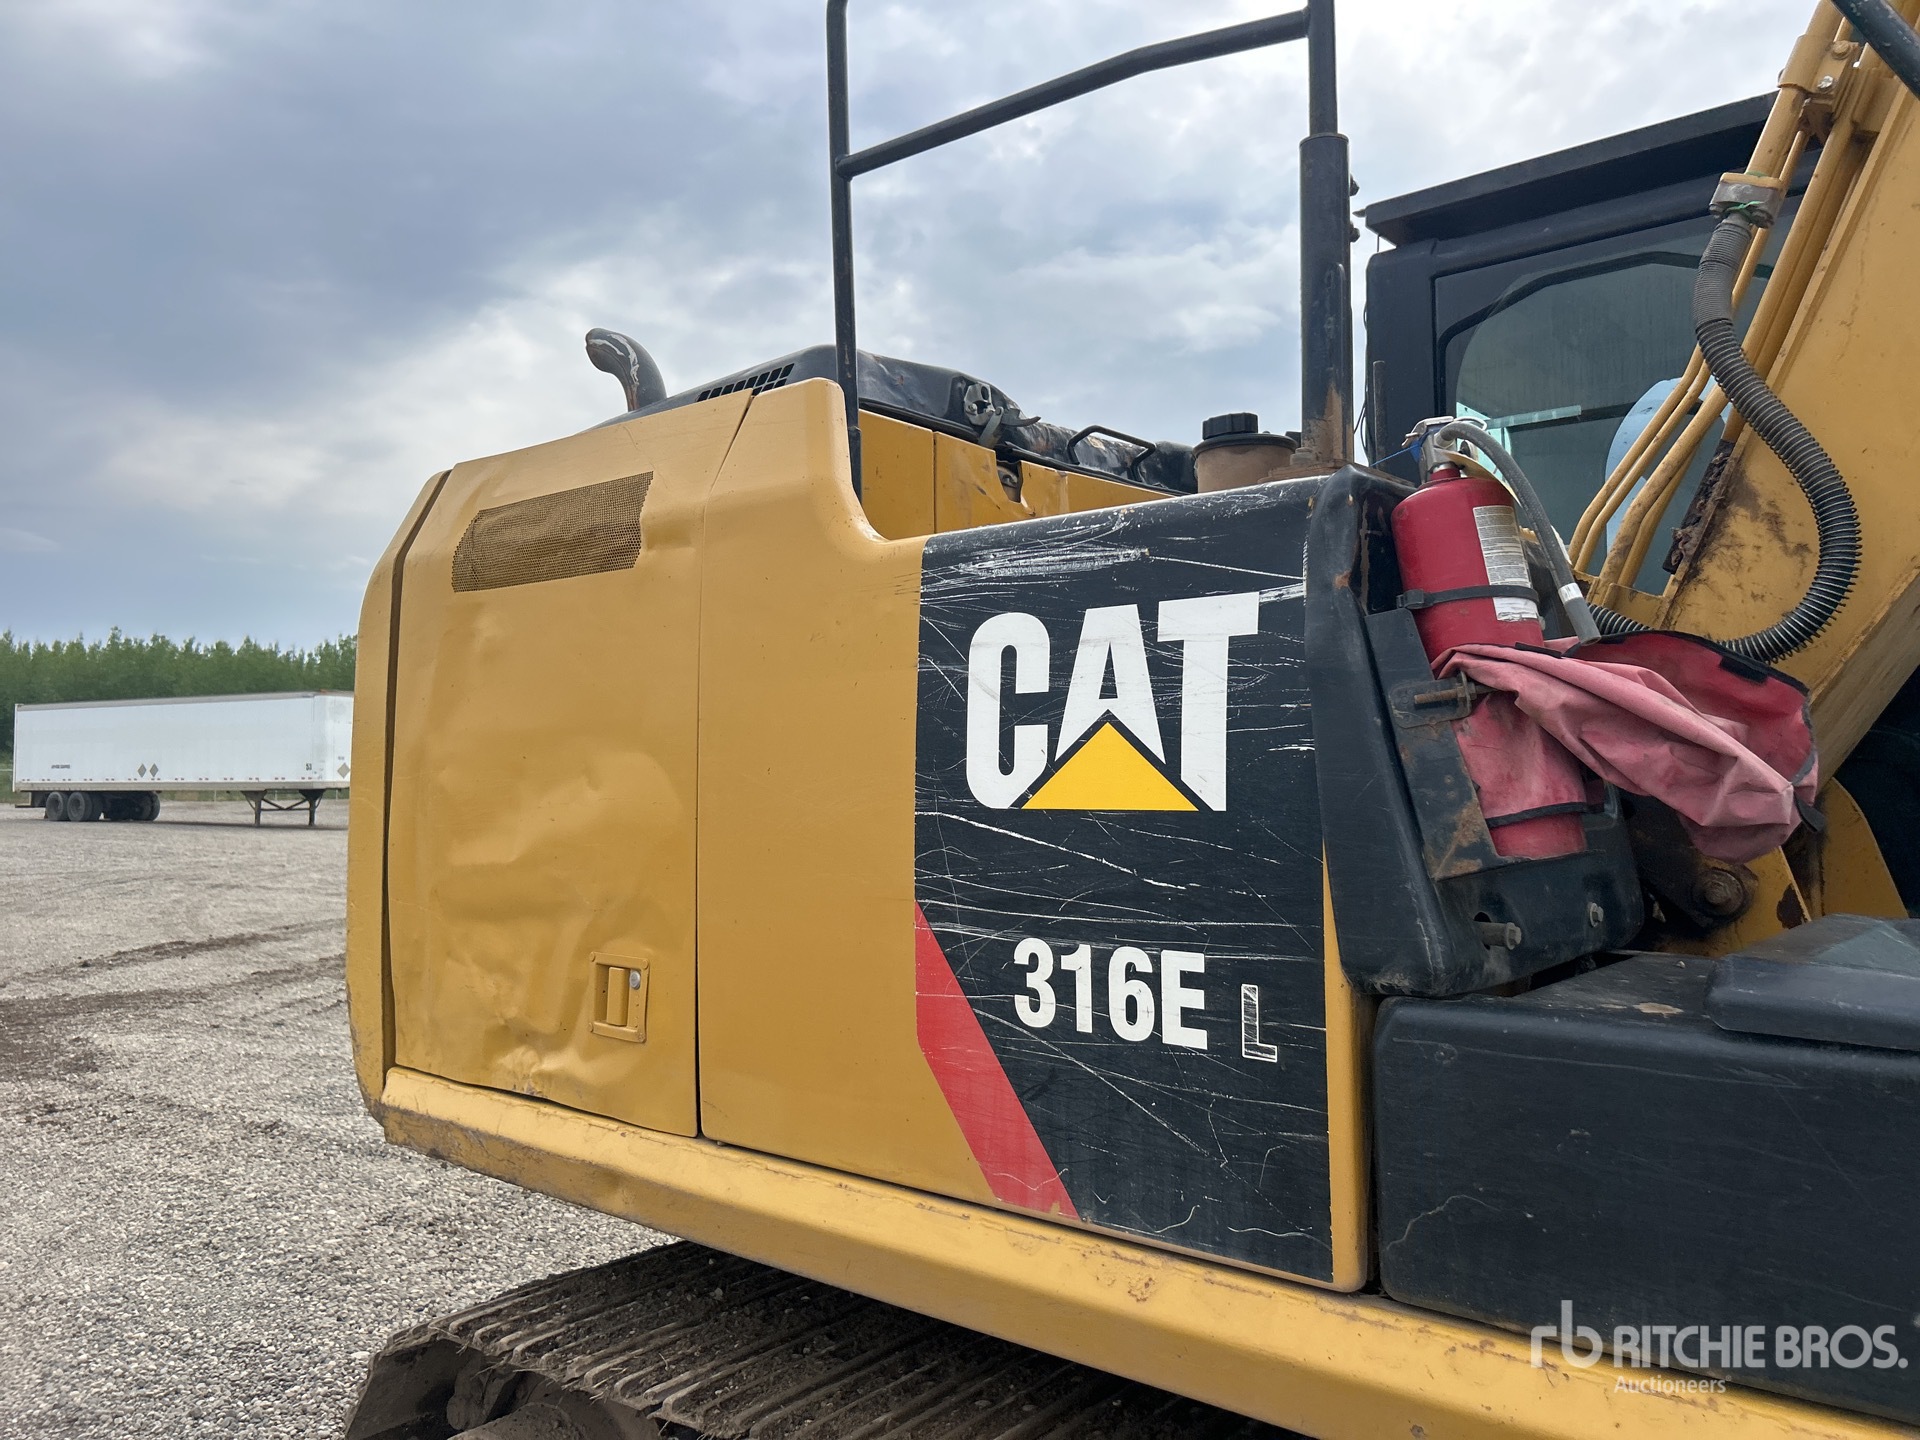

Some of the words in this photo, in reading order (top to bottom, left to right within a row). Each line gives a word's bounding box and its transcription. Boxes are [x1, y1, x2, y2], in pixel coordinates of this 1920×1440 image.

[966, 591, 1260, 812] CAT
[1013, 937, 1209, 1050] 316E
[1240, 984, 1278, 1063] L
